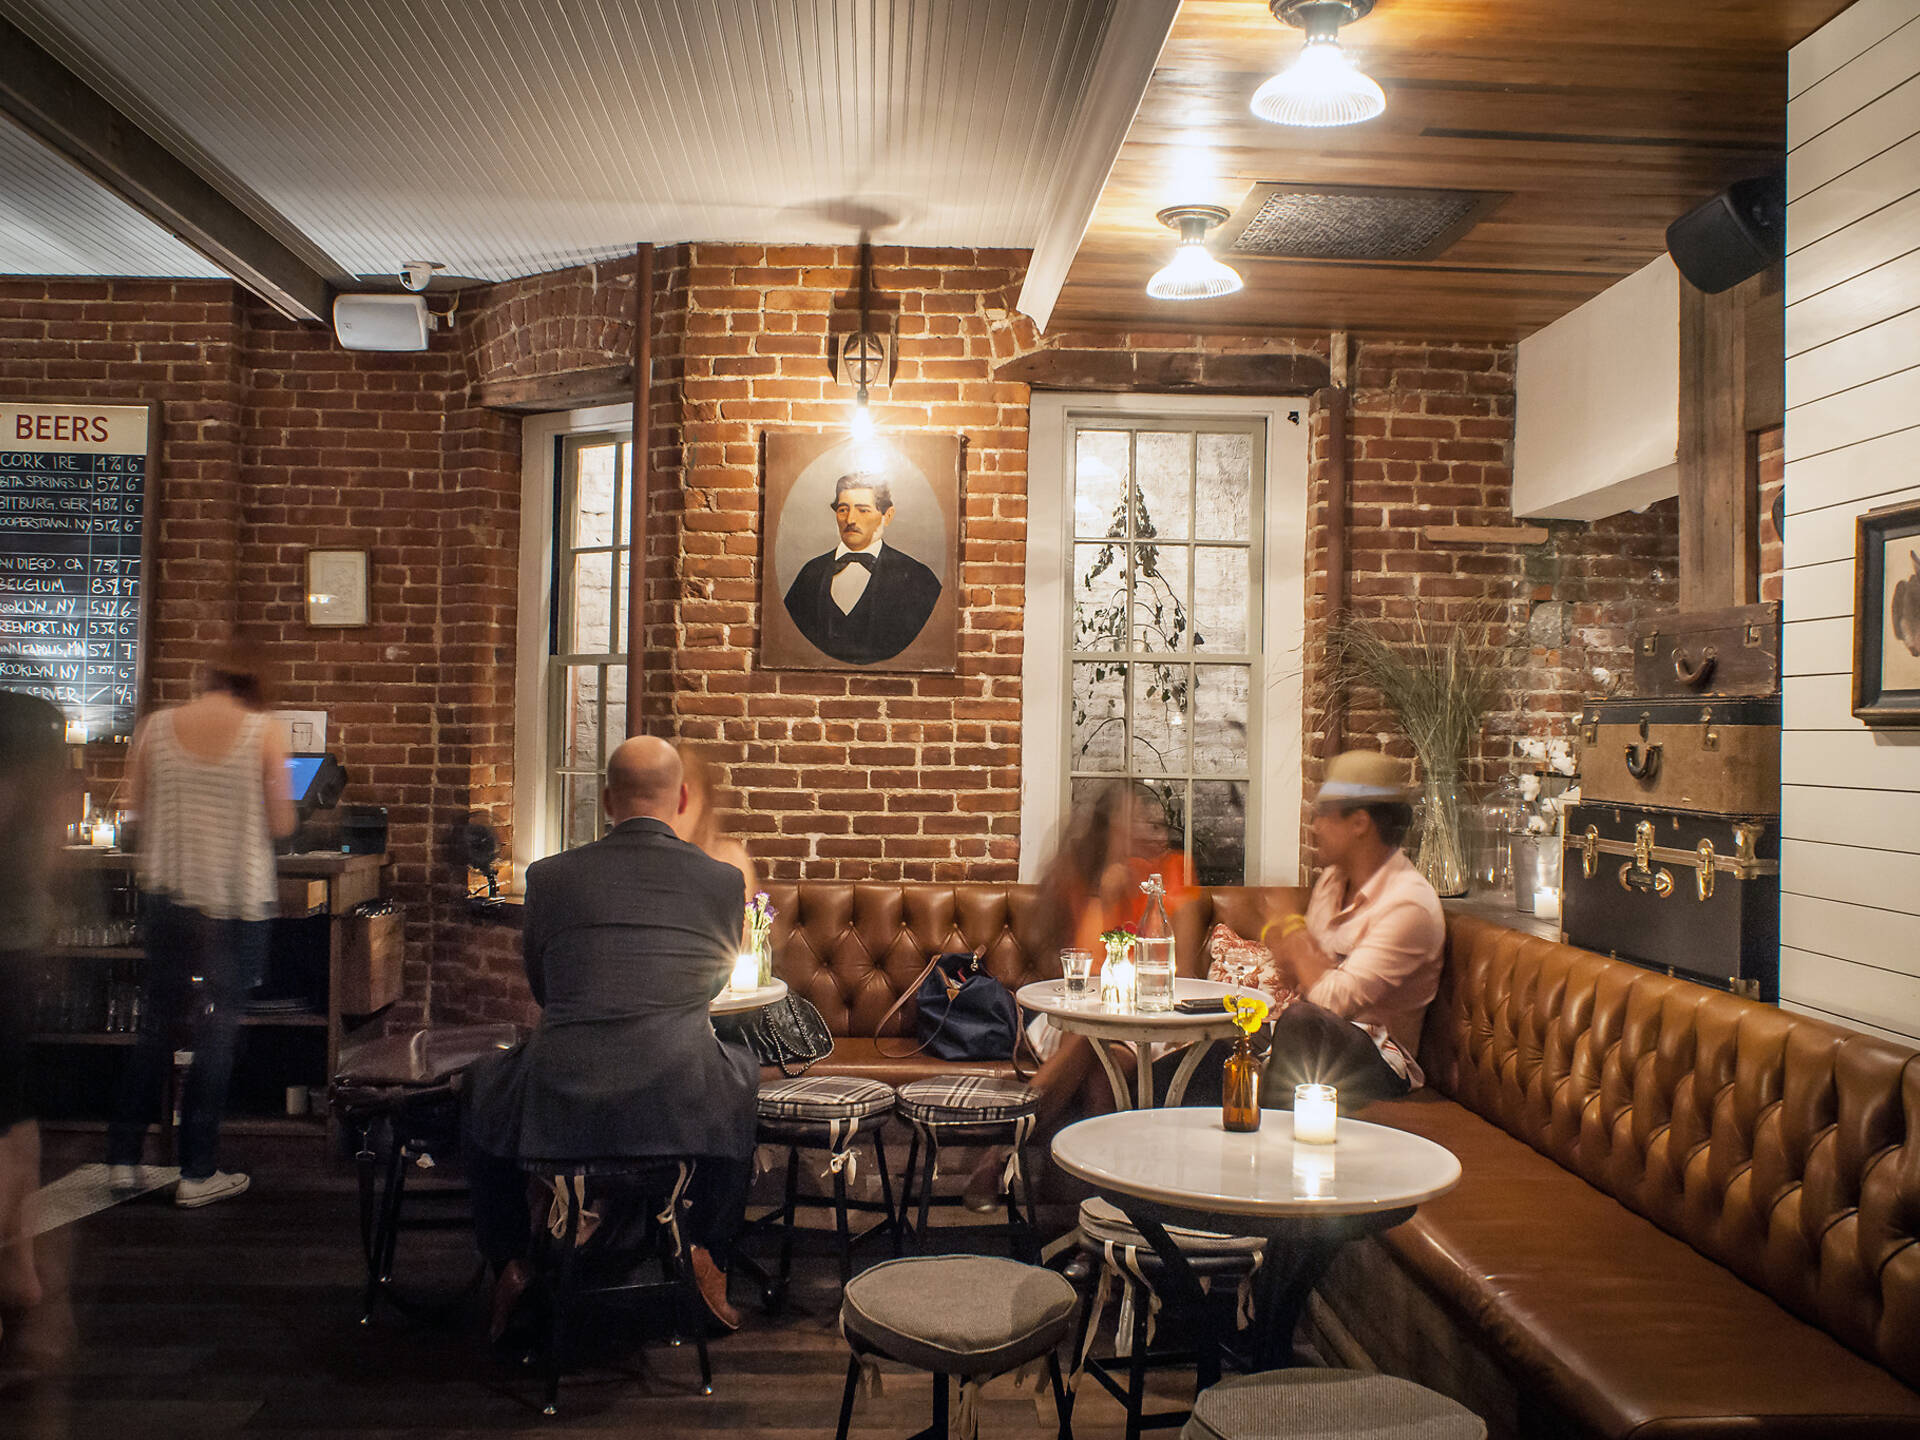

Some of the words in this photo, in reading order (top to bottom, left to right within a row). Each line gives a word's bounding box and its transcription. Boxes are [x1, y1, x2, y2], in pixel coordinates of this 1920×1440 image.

[16, 414, 109, 443] BEERS
[54, 456, 80, 470] IRE
[97, 476, 120, 492] 5%
[60, 497, 90, 512] GER
[74, 518, 92, 534] NY
[65, 558, 84, 570] CA
[56, 598, 76, 615] NY
[62, 622, 81, 637] NY
[60, 663, 80, 680] NY
